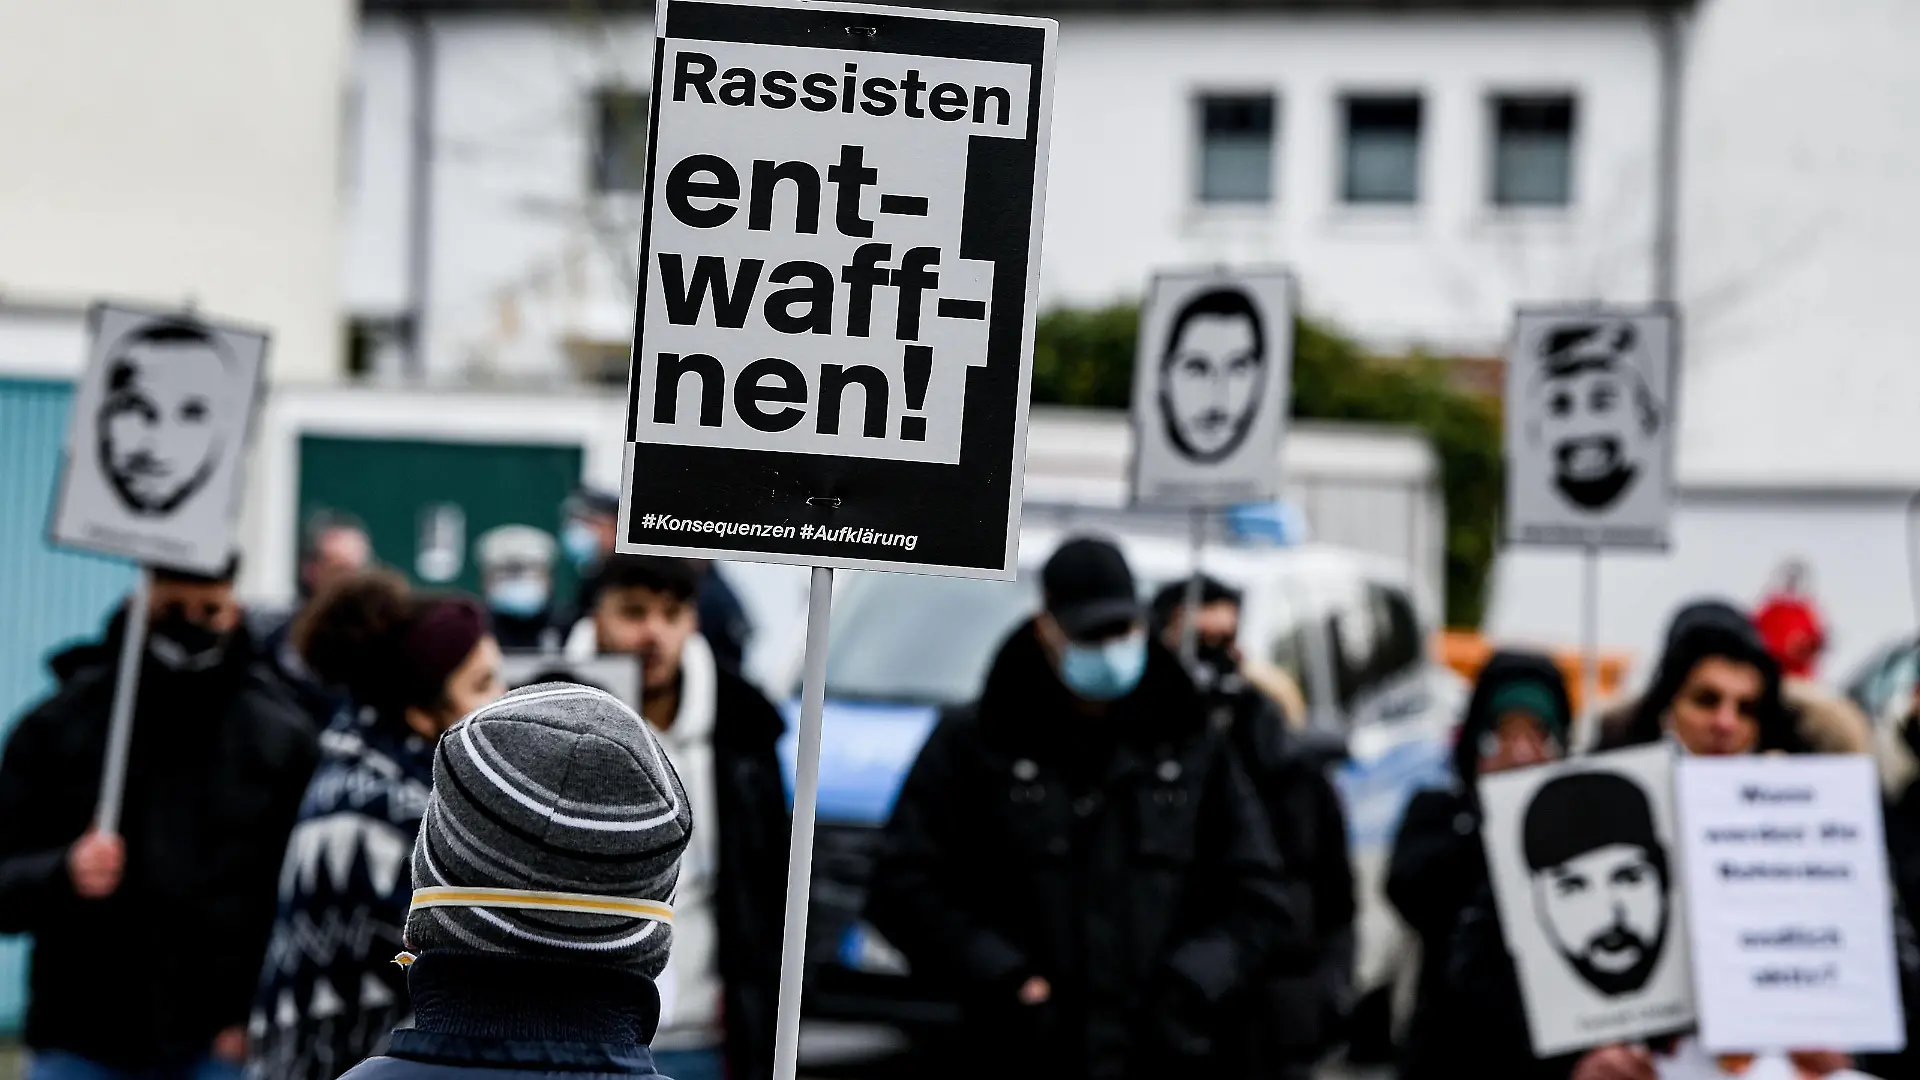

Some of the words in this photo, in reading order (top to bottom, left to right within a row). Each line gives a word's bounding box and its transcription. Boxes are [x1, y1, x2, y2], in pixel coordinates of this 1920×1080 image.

[672, 51, 1011, 126] Rassisten
[665, 144, 929, 239] ent-
[657, 242, 987, 342] waff-
[652, 344, 935, 443] nen!
[641, 513, 796, 540] #Konsequenzen
[799, 523, 919, 551] #Aufklärung
